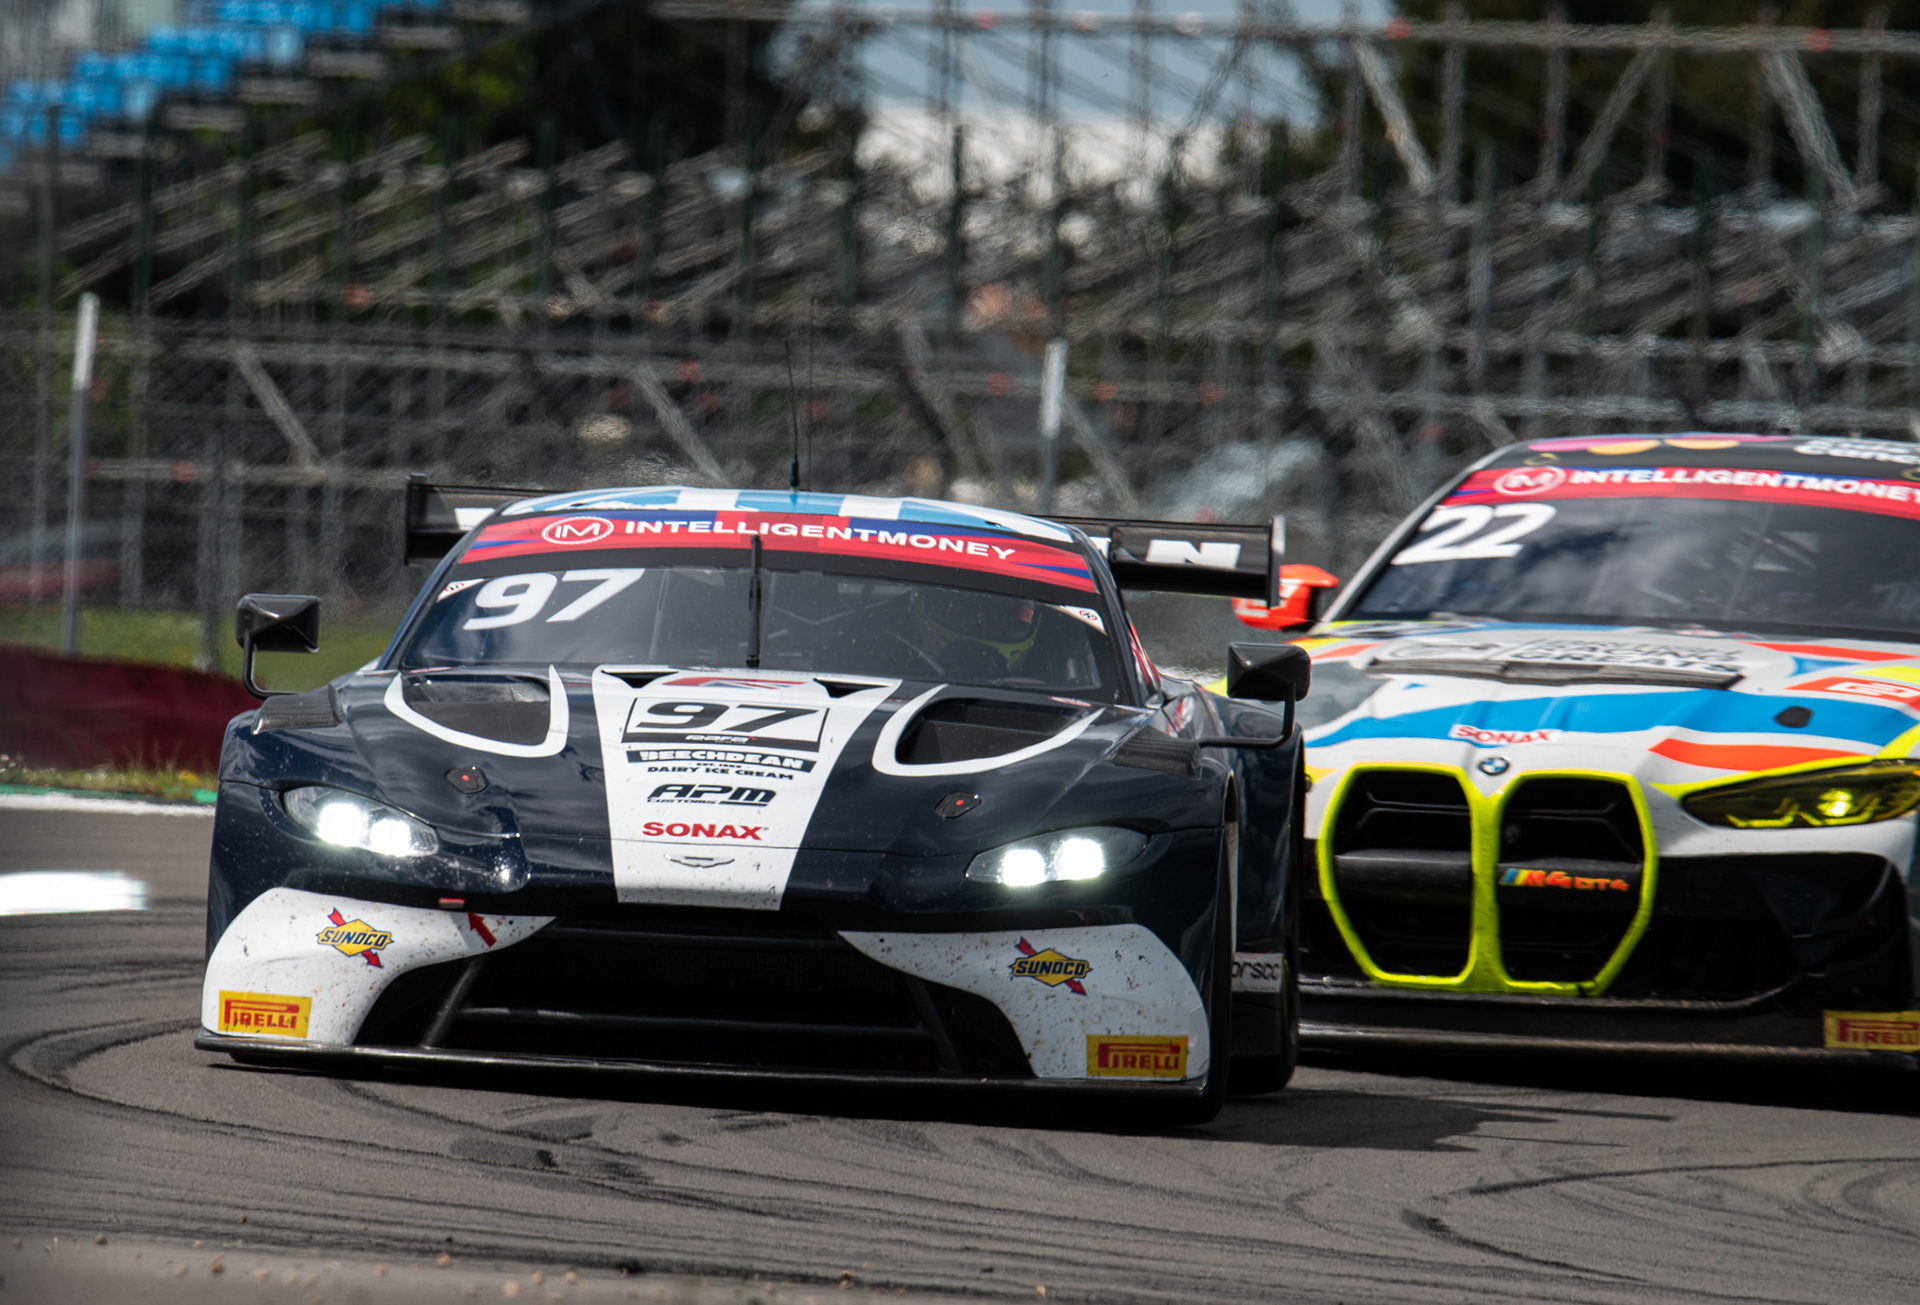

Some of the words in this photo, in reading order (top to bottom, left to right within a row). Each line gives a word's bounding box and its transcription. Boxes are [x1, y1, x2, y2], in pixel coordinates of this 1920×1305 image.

[625, 519, 1016, 560] INTELLIGENTMONEY
[1391, 502, 1557, 566] 22
[463, 568, 646, 631] 97
[635, 701, 820, 733] 97
[1456, 725, 1553, 744] SONAX
[639, 750, 805, 769] BEECHDEAN
[647, 766, 699, 774] DAIRY
[704, 767, 730, 775] ICE
[734, 769, 794, 781] CREAM
[647, 783, 777, 803] APM
[642, 821, 763, 841] SONAX
[321, 930, 389, 948] SUNOCO
[1015, 959, 1087, 976] SUNOCO
[224, 999, 300, 1030] PIRELLI
[1097, 1042, 1181, 1070] PIRELLI
